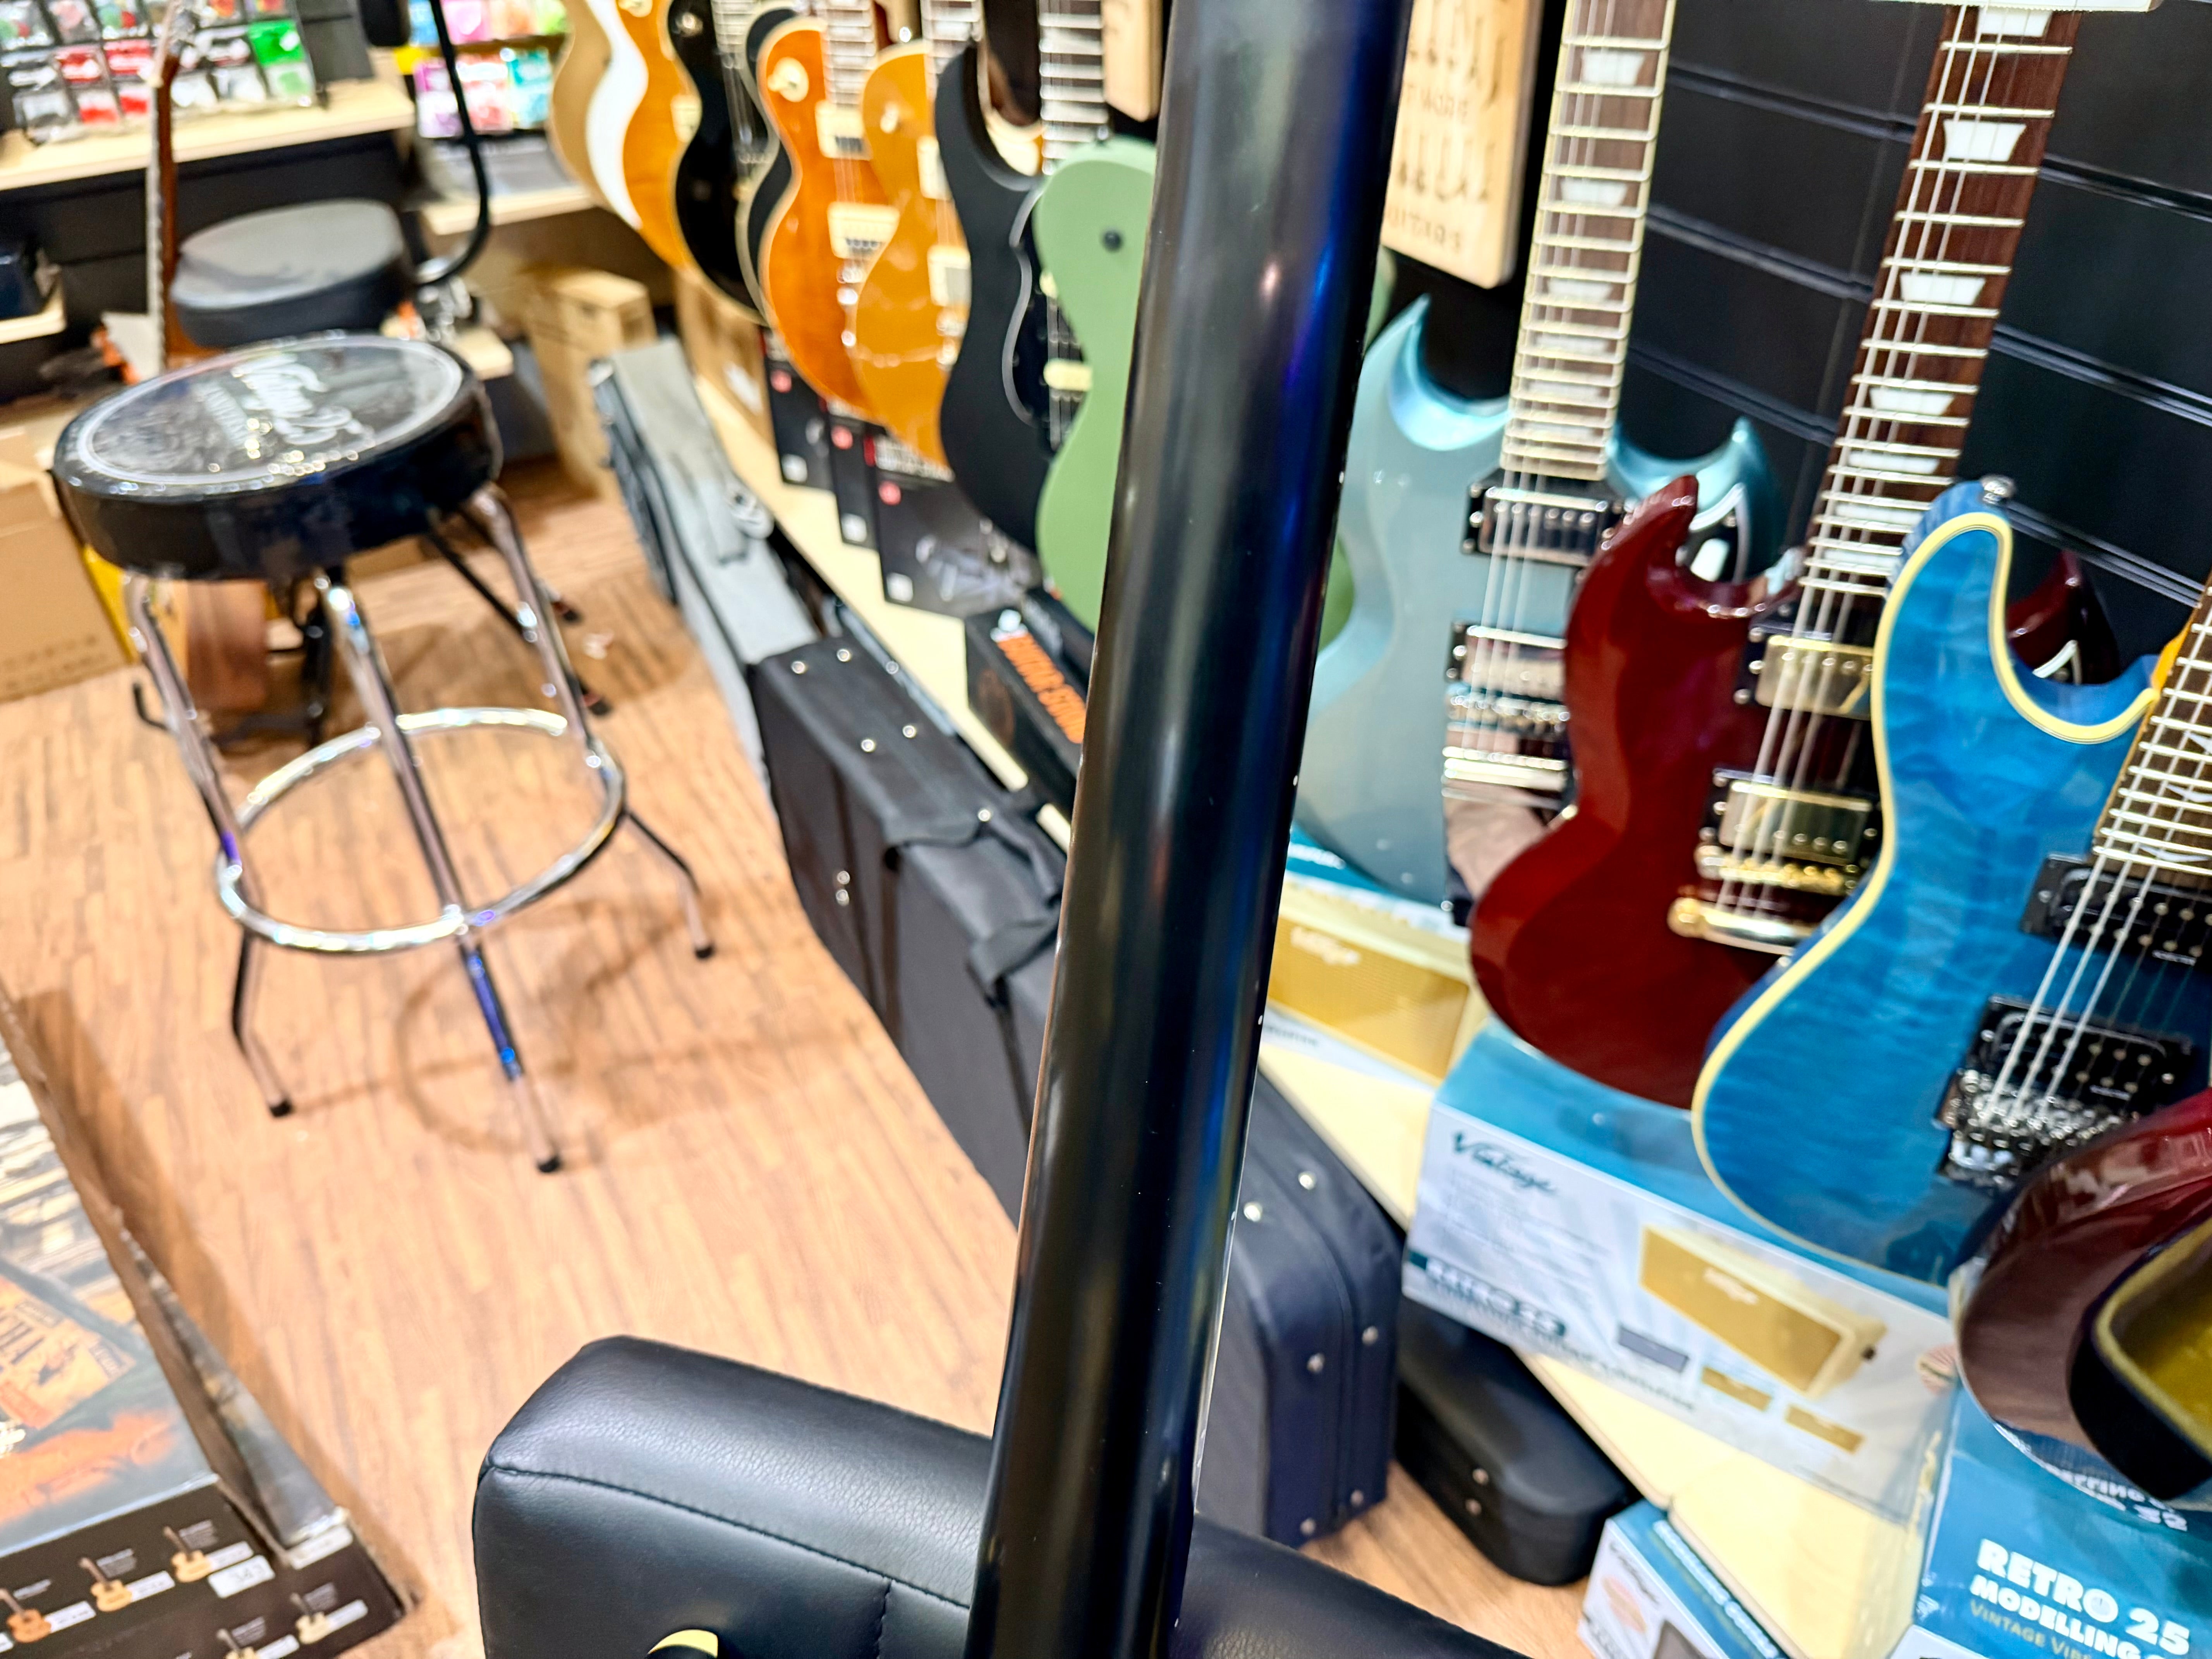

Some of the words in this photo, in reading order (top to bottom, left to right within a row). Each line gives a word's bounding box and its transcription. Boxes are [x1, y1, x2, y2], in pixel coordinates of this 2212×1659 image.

[1970, 1574, 2141, 1659] MODELLING
[1977, 1538, 2119, 1623] RETRO
[2125, 1607, 2190, 1656] 25
